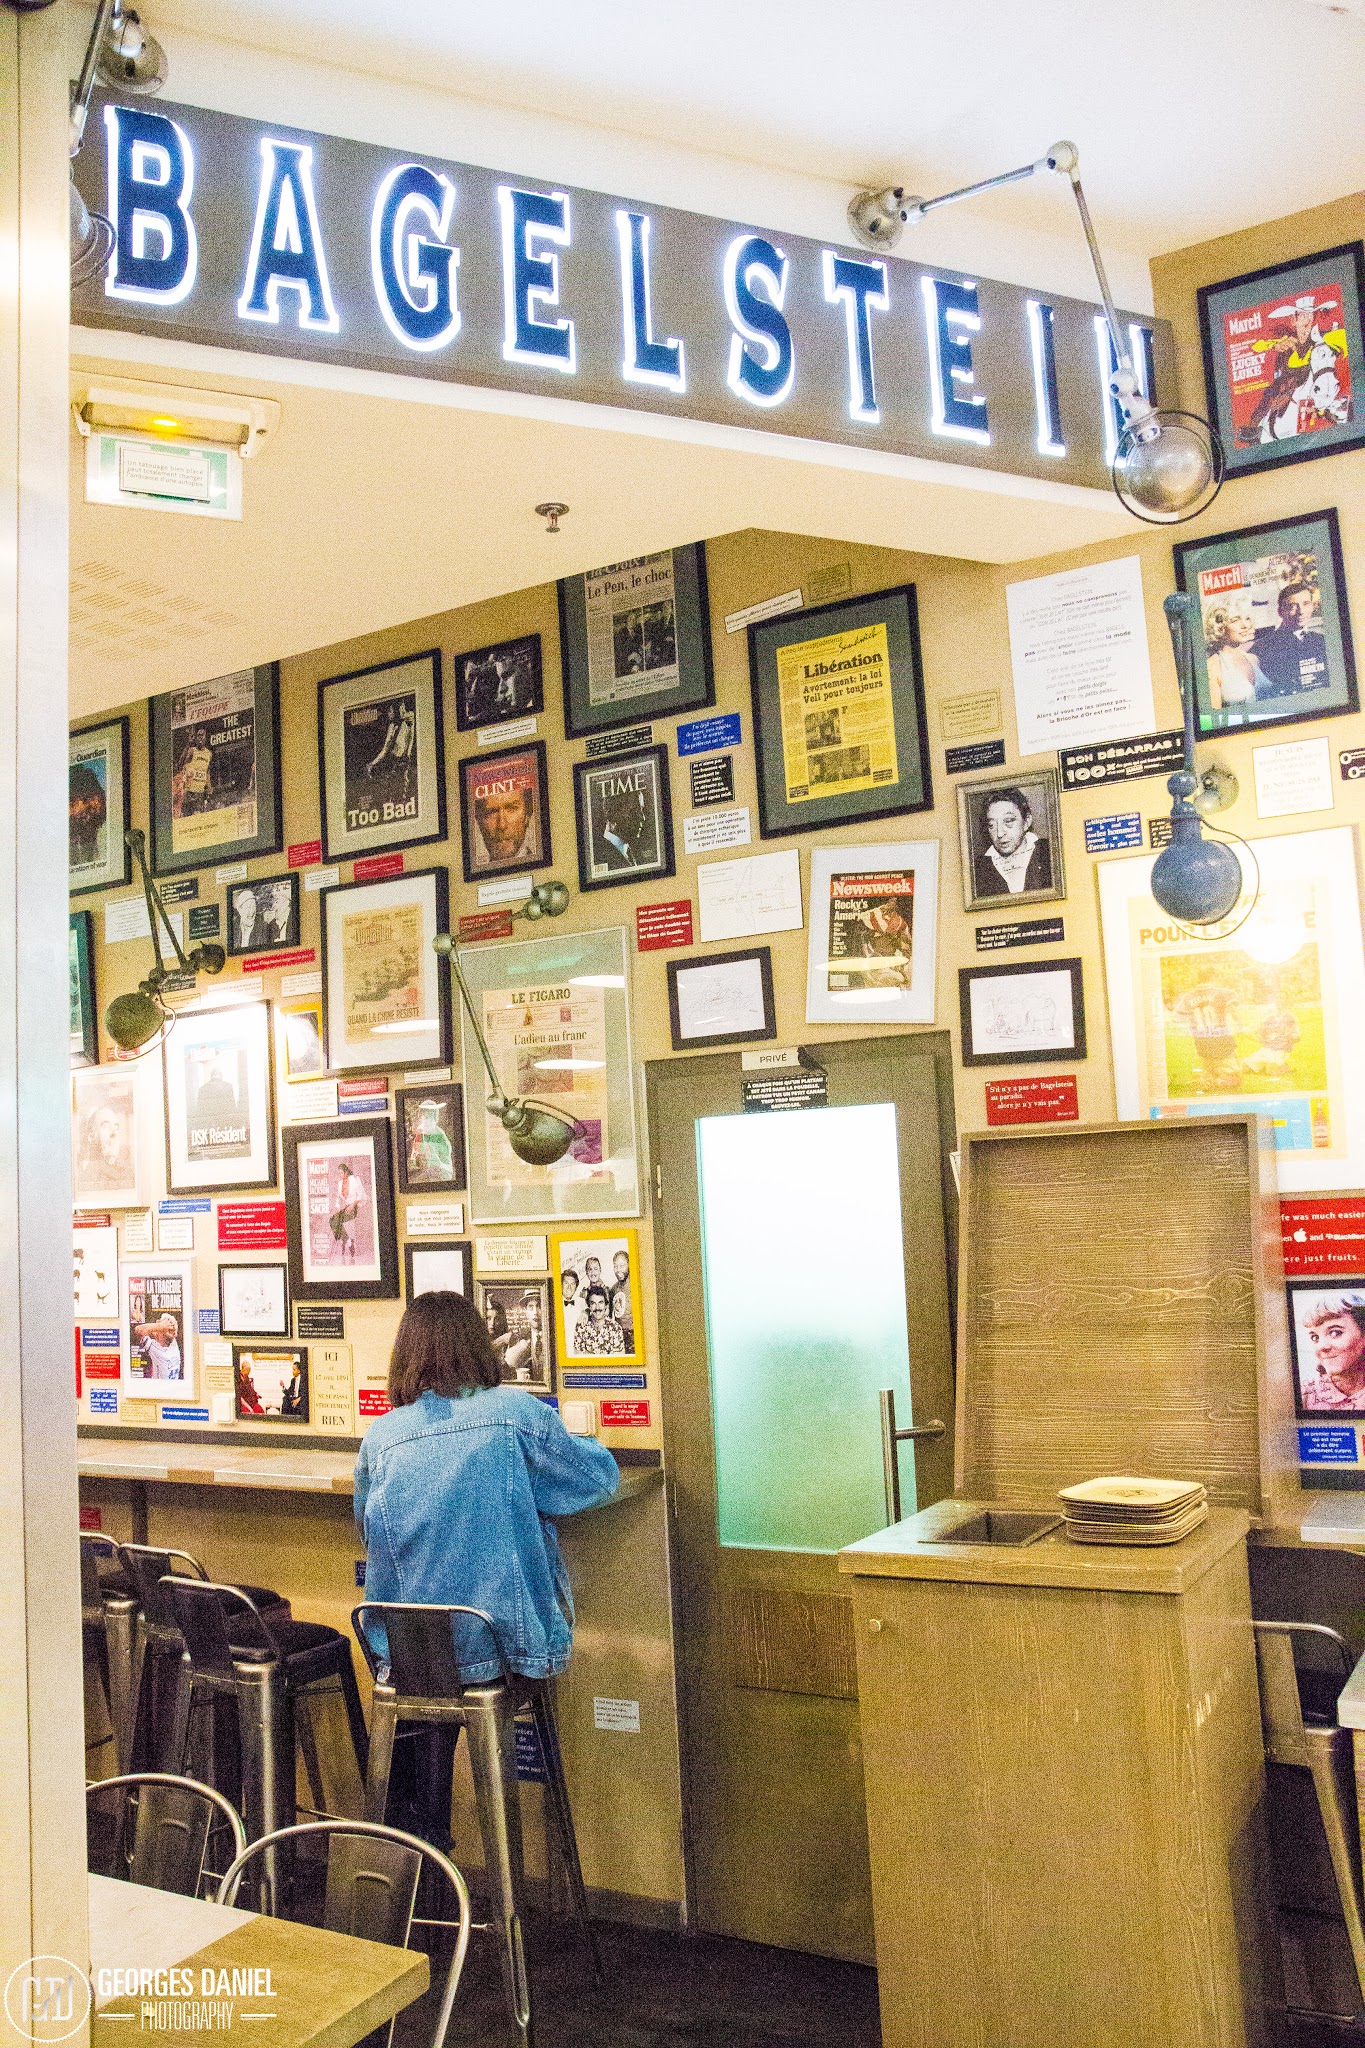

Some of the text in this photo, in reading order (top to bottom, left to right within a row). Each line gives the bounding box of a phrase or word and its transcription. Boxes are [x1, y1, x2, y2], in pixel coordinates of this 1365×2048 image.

[104, 104, 1155, 469] BAGELSTEIN
[1231, 353, 1266, 371] LUCKY
[1232, 365, 1262, 382] LUKE
[587, 568, 673, 600] Le Pen, le choc
[1024, 650, 1036, 659] pas
[1113, 630, 1132, 639] mode
[803, 653, 884, 679] Libération
[802, 667, 883, 694] Avortement: la loi
[803, 681, 884, 704] Veil pour toujours
[222, 714, 239, 731] THE
[1056, 714, 1080, 723] Brioche
[210, 725, 253, 746] GREATEST
[77, 748, 107, 767] Guardian
[1066, 739, 1173, 767] BON DÉBARRAS
[474, 778, 517, 799] CLINT
[596, 772, 648, 799] TIME
[348, 796, 417, 828] Too Bad
[1107, 826, 1137, 836] hommes
[832, 878, 912, 897] Newsweek
[834, 898, 869, 912] Rocky's
[1139, 919, 1194, 945] POUR
[511, 987, 571, 1005] LE FIGARO
[368, 1012, 377, 1023] LA
[513, 1029, 588, 1046] L'adieu au franc
[759, 1052, 788, 1064] PRIVÉ
[752, 1081, 772, 1089] CHAQUE
[800, 1076, 824, 1084] PLATEAU
[1040, 1081, 1074, 1091] Bagelstein
[191, 1126, 247, 1147] DSK Résident
[1311, 1211, 1336, 1221] much
[1337, 1210, 1365, 1219] easier
[1309, 1233, 1325, 1242] and
[1303, 1254, 1324, 1265] just
[324, 1351, 338, 1362] ICI
[321, 1415, 346, 1426] RIEN
